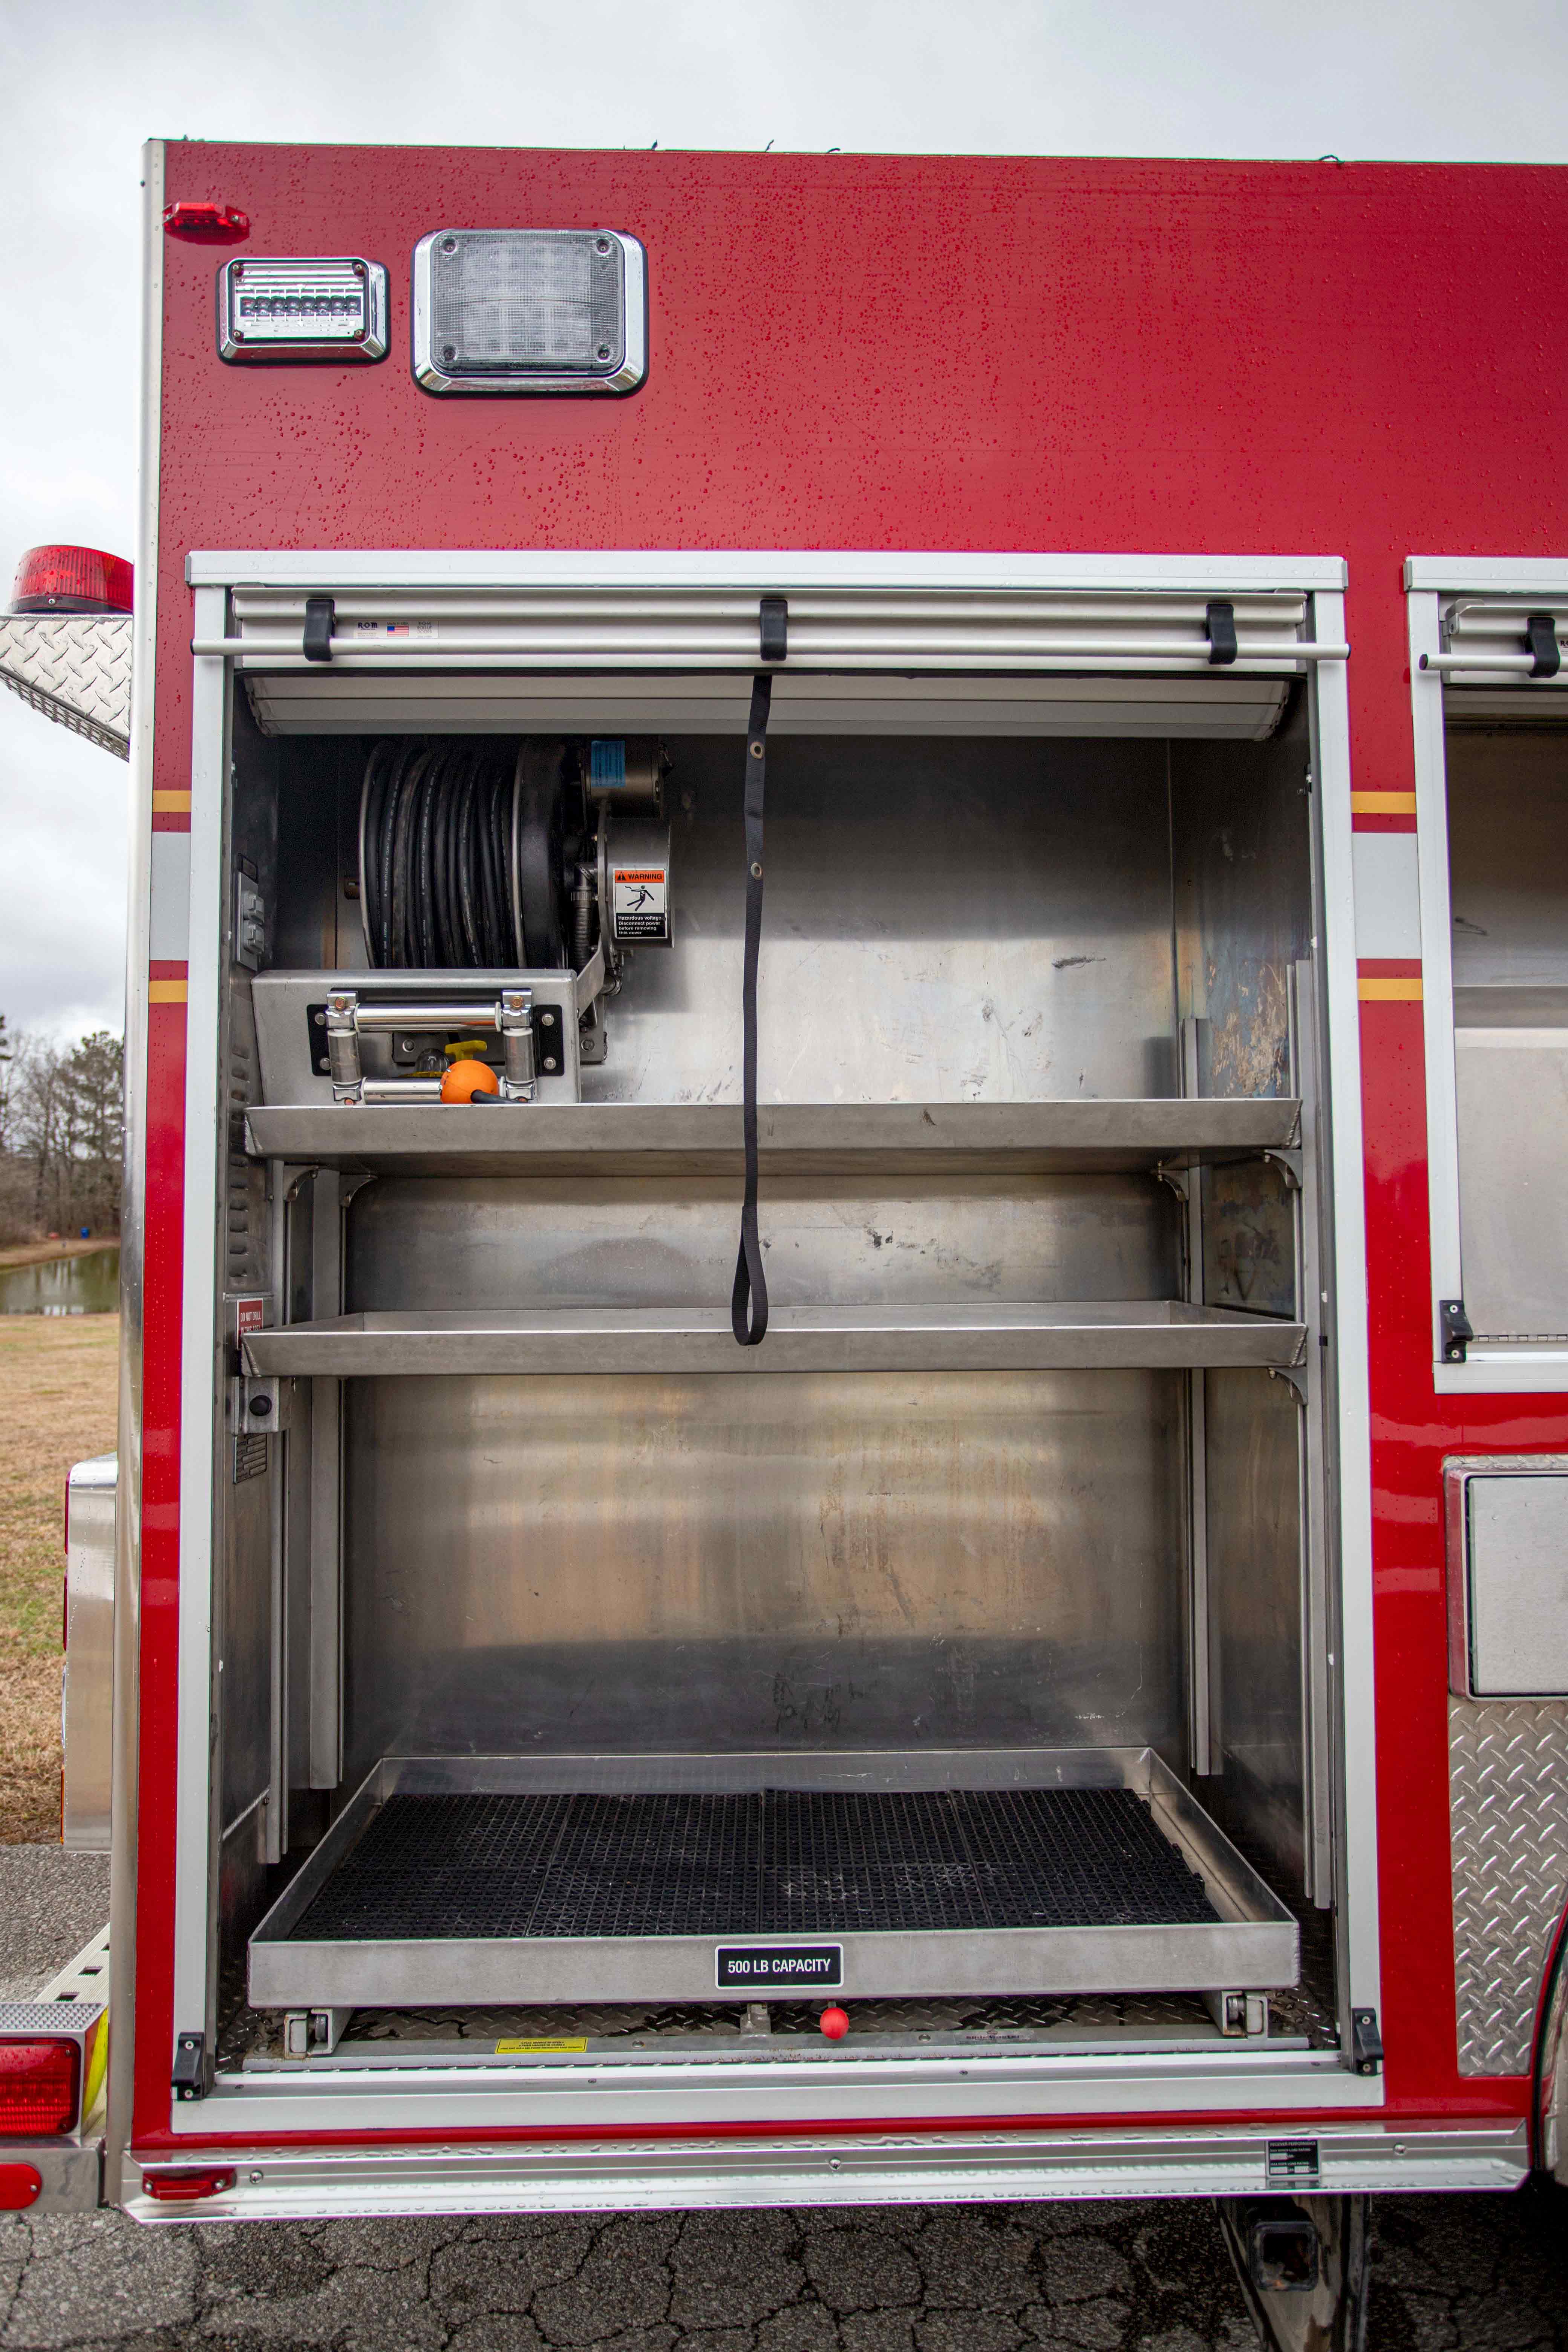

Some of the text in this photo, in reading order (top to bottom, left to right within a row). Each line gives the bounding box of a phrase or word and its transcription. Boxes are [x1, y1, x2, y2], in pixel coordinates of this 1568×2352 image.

[240, 1312, 245, 1322] DO
[253, 1311, 262, 1320] DRILL
[728, 1958, 831, 1974] 500 LB CAPACITY
